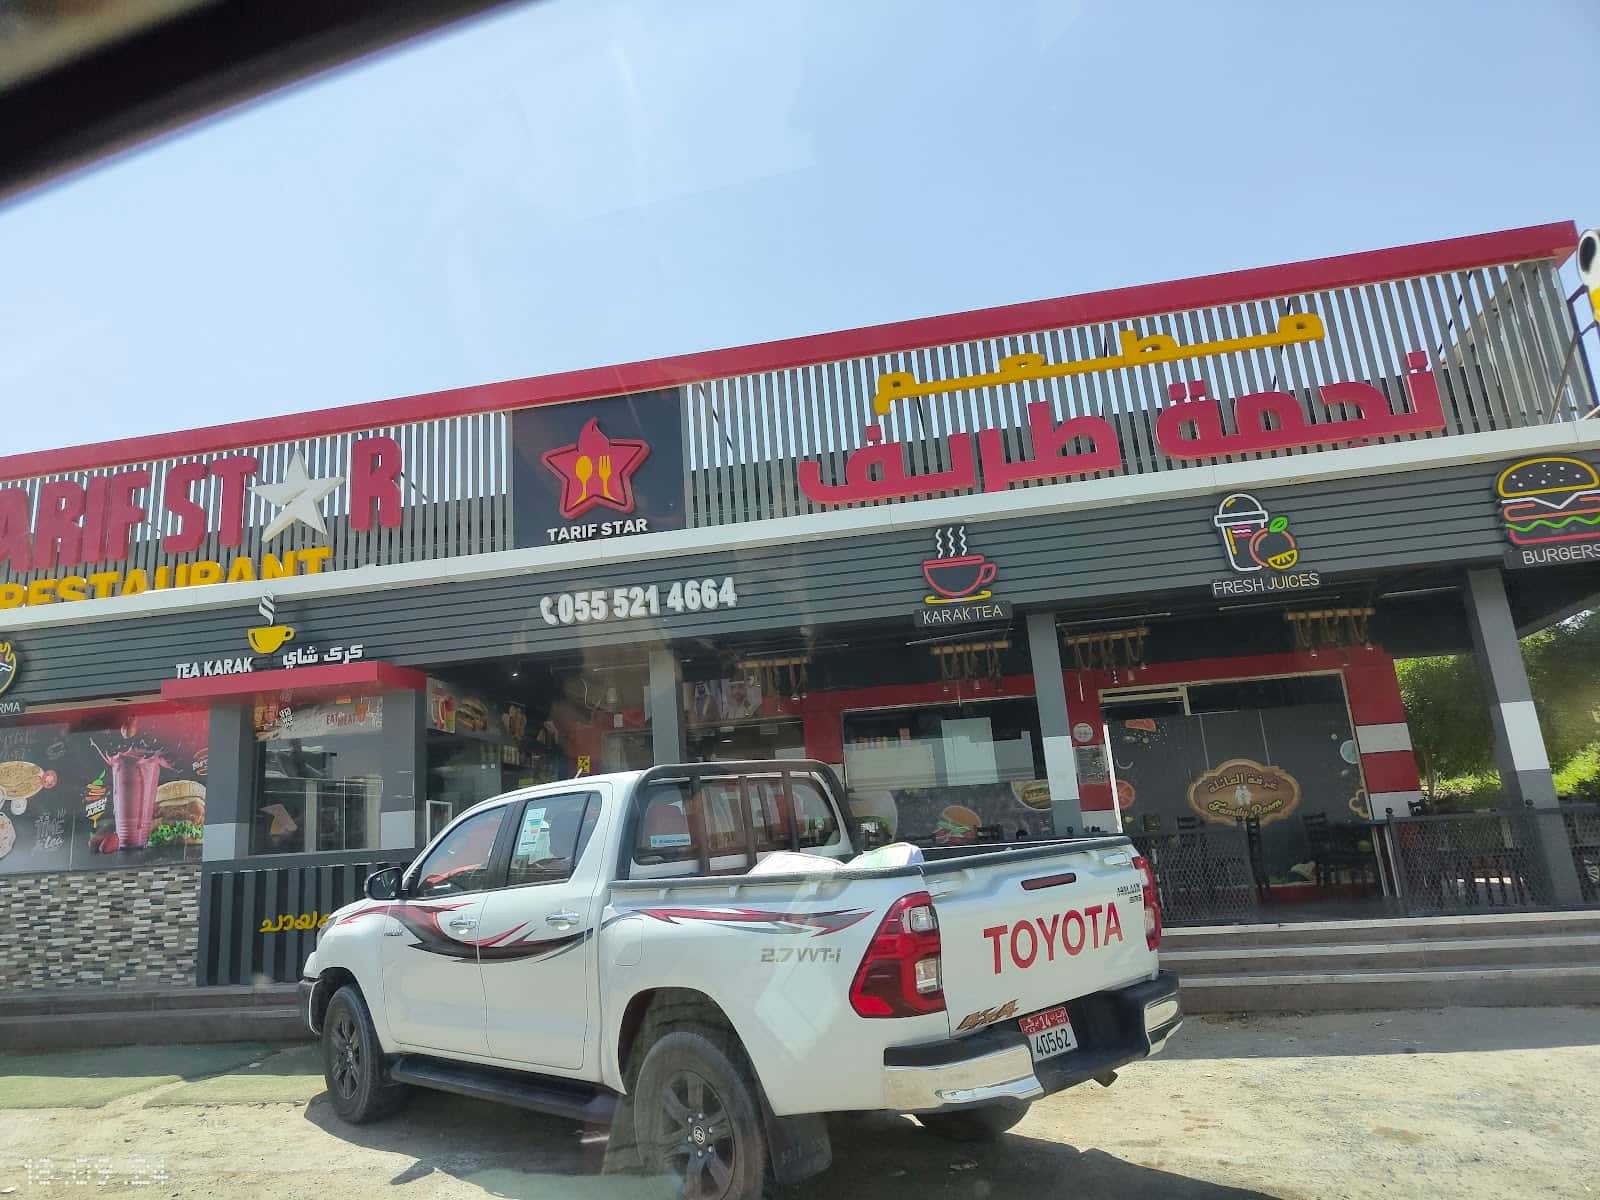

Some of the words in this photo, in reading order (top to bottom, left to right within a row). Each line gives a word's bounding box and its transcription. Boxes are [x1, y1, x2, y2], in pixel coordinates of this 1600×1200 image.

[872, 311, 1327, 415] مطعم
[547, 523, 597, 542] TARIF
[602, 518, 648, 536] STAR
[1213, 577, 1265, 595] FRESH
[1267, 573, 1320, 590] JUICES
[558, 589, 608, 625] 055
[613, 585, 660, 618] 521
[667, 577, 737, 612] 4664
[921, 608, 970, 625] KARAK
[971, 604, 1004, 621] TEA
[176, 663, 200, 679] TEA
[203, 657, 253, 677] KARAK
[282, 646, 318, 669] شاي
[1208, 800, 1249, 817] Family
[1251, 799, 1283, 815] Room
[983, 902, 1123, 974] TOYOTA
[761, 947, 794, 962] 2.7
[1039, 1013, 1051, 1028] 14
[1036, 1028, 1071, 1057] 40562
